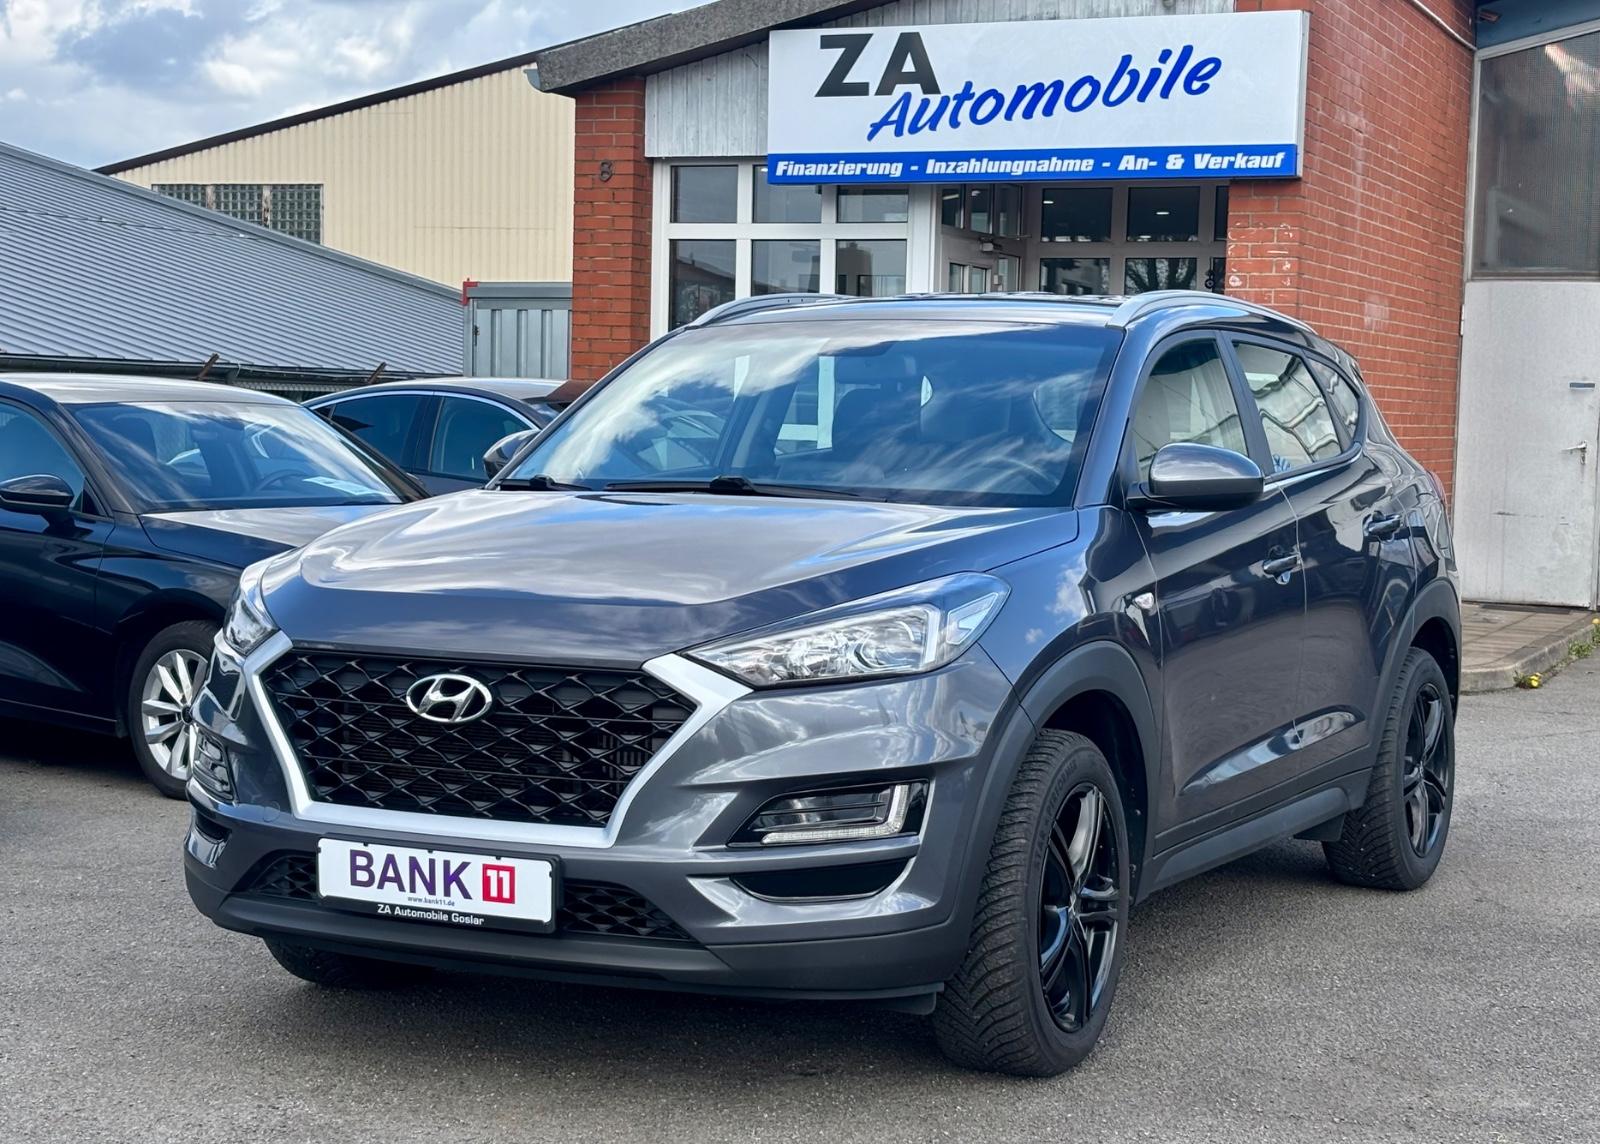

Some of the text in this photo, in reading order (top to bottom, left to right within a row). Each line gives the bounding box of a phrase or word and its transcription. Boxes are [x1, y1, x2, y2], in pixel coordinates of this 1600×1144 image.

[815, 33, 941, 98] ZA
[867, 44, 1223, 141] Automobile
[600, 159, 614, 182] 8
[776, 161, 903, 178] Finanzierung
[926, 156, 1095, 176] Inzahlungnahme
[1118, 155, 1158, 171] An-
[1166, 155, 1185, 170] &
[1194, 151, 1286, 170] Verkauf
[350, 849, 512, 899] BANK 11
[377, 904, 485, 925] ZA Automobile Goslar
[407, 896, 456, 907] www.bank11.de
